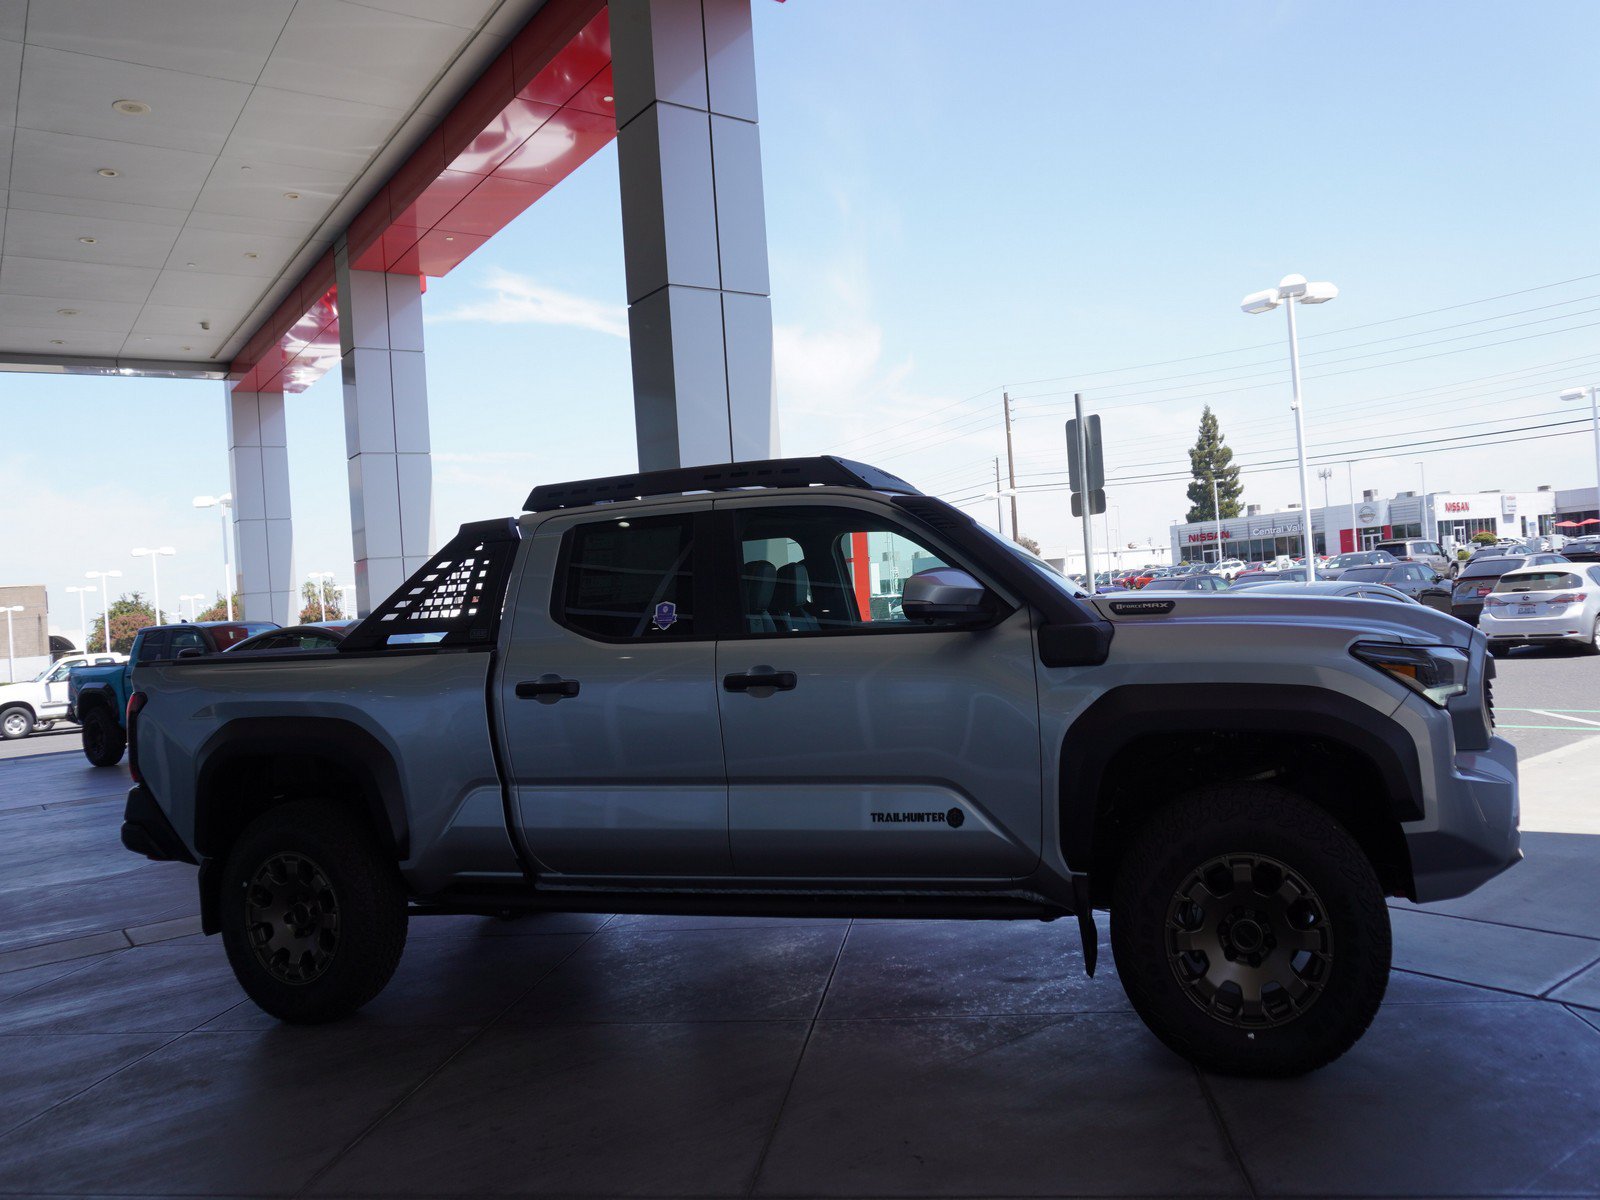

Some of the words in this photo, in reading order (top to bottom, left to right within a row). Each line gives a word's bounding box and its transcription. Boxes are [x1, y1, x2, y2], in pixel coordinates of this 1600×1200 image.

[1445, 502, 1469, 513] NISSAN
[1252, 526, 1284, 536] Central
[871, 812, 946, 823] TRAILHUNTER
